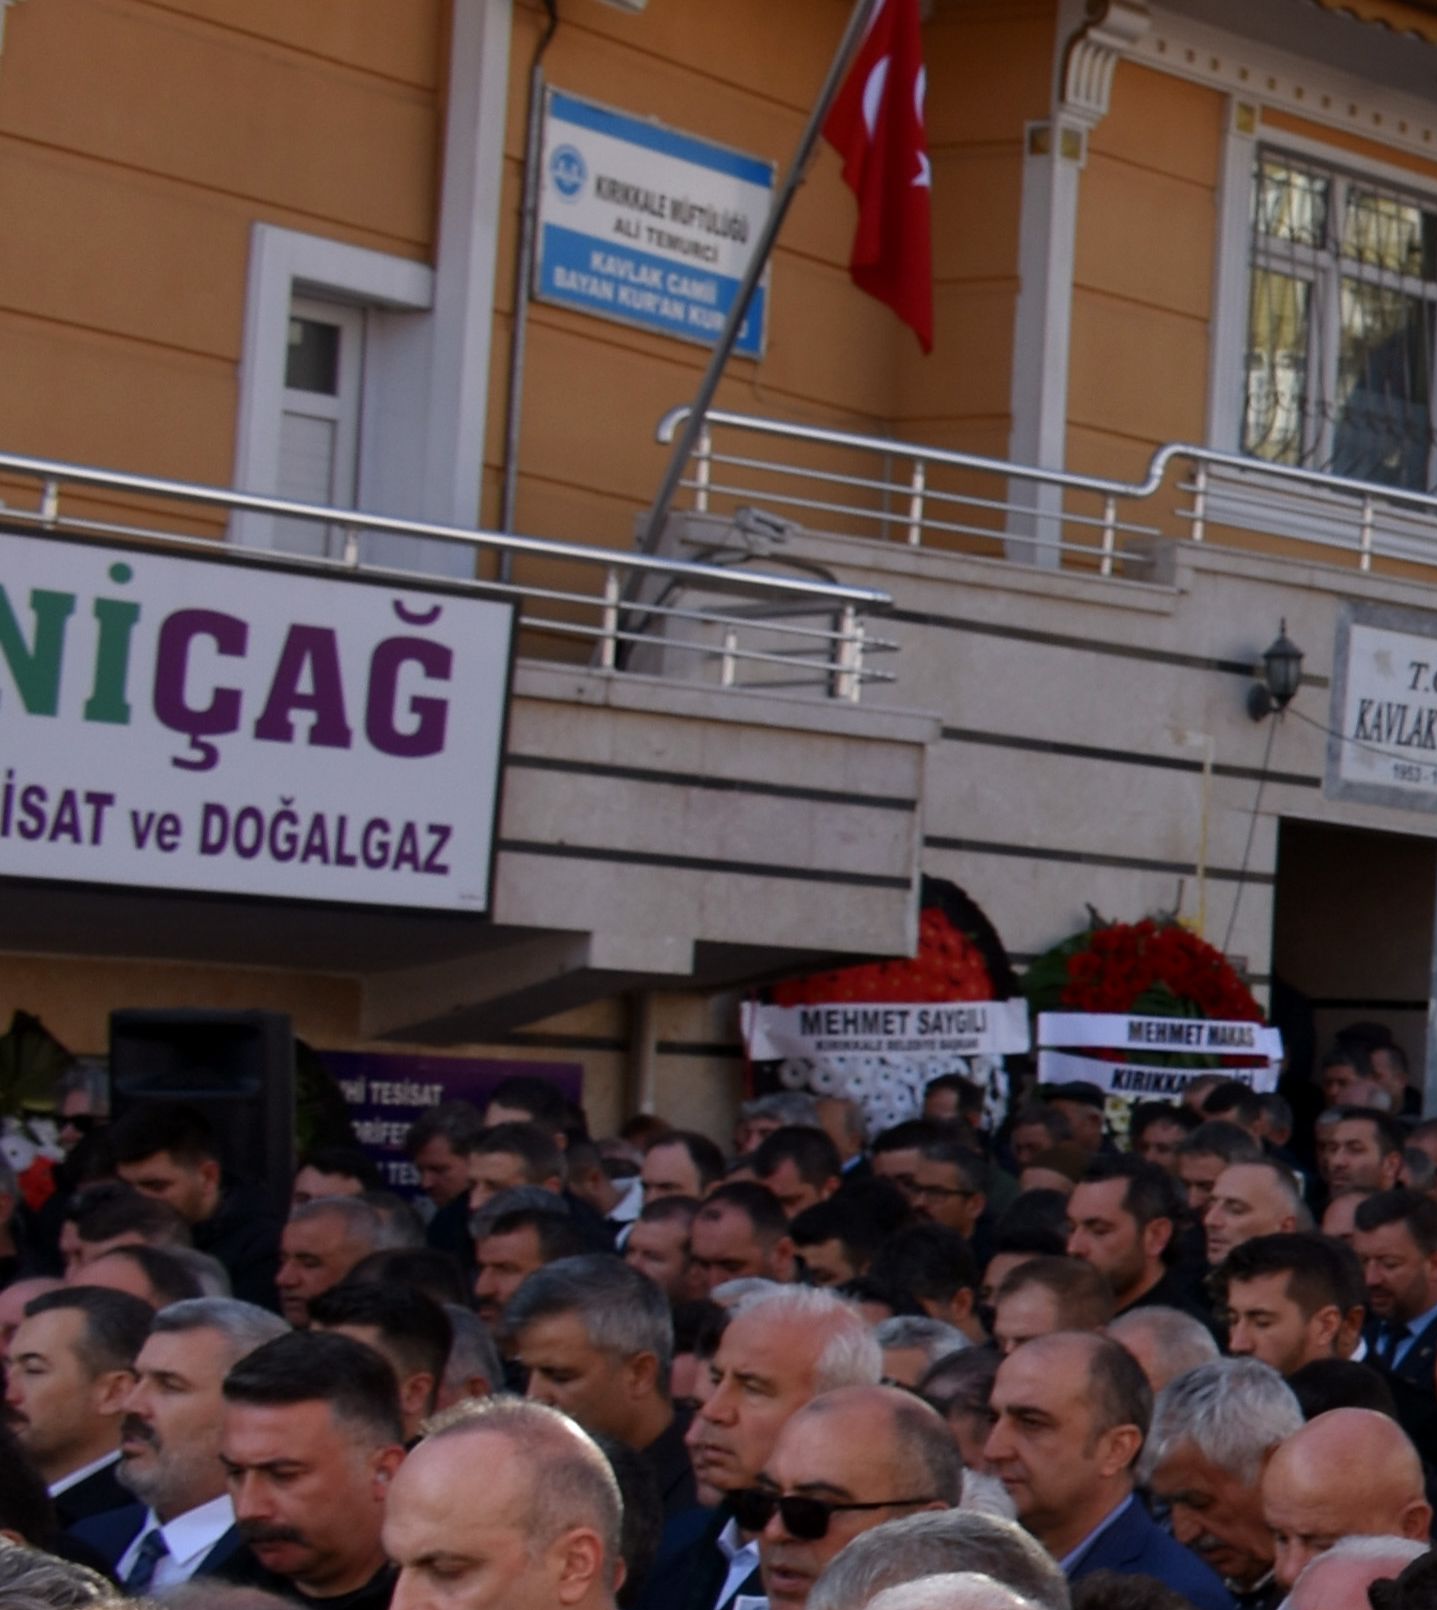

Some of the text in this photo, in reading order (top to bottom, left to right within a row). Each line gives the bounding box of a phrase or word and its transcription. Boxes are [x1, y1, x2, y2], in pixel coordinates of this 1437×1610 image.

[594, 174, 666, 219] KIRIKKALE
[613, 217, 641, 240] ALİ
[591, 251, 663, 289] KAVLAK
[553, 265, 615, 301] BAYAN
[618, 285, 686, 320] KUR'AN
[130, 809, 183, 855] ve
[198, 795, 454, 877] DOĞALGAZ
[801, 1009, 909, 1037] MEHMET
[1128, 1020, 1204, 1046] MEHMET
[370, 1078, 444, 1107] TESİSAT
